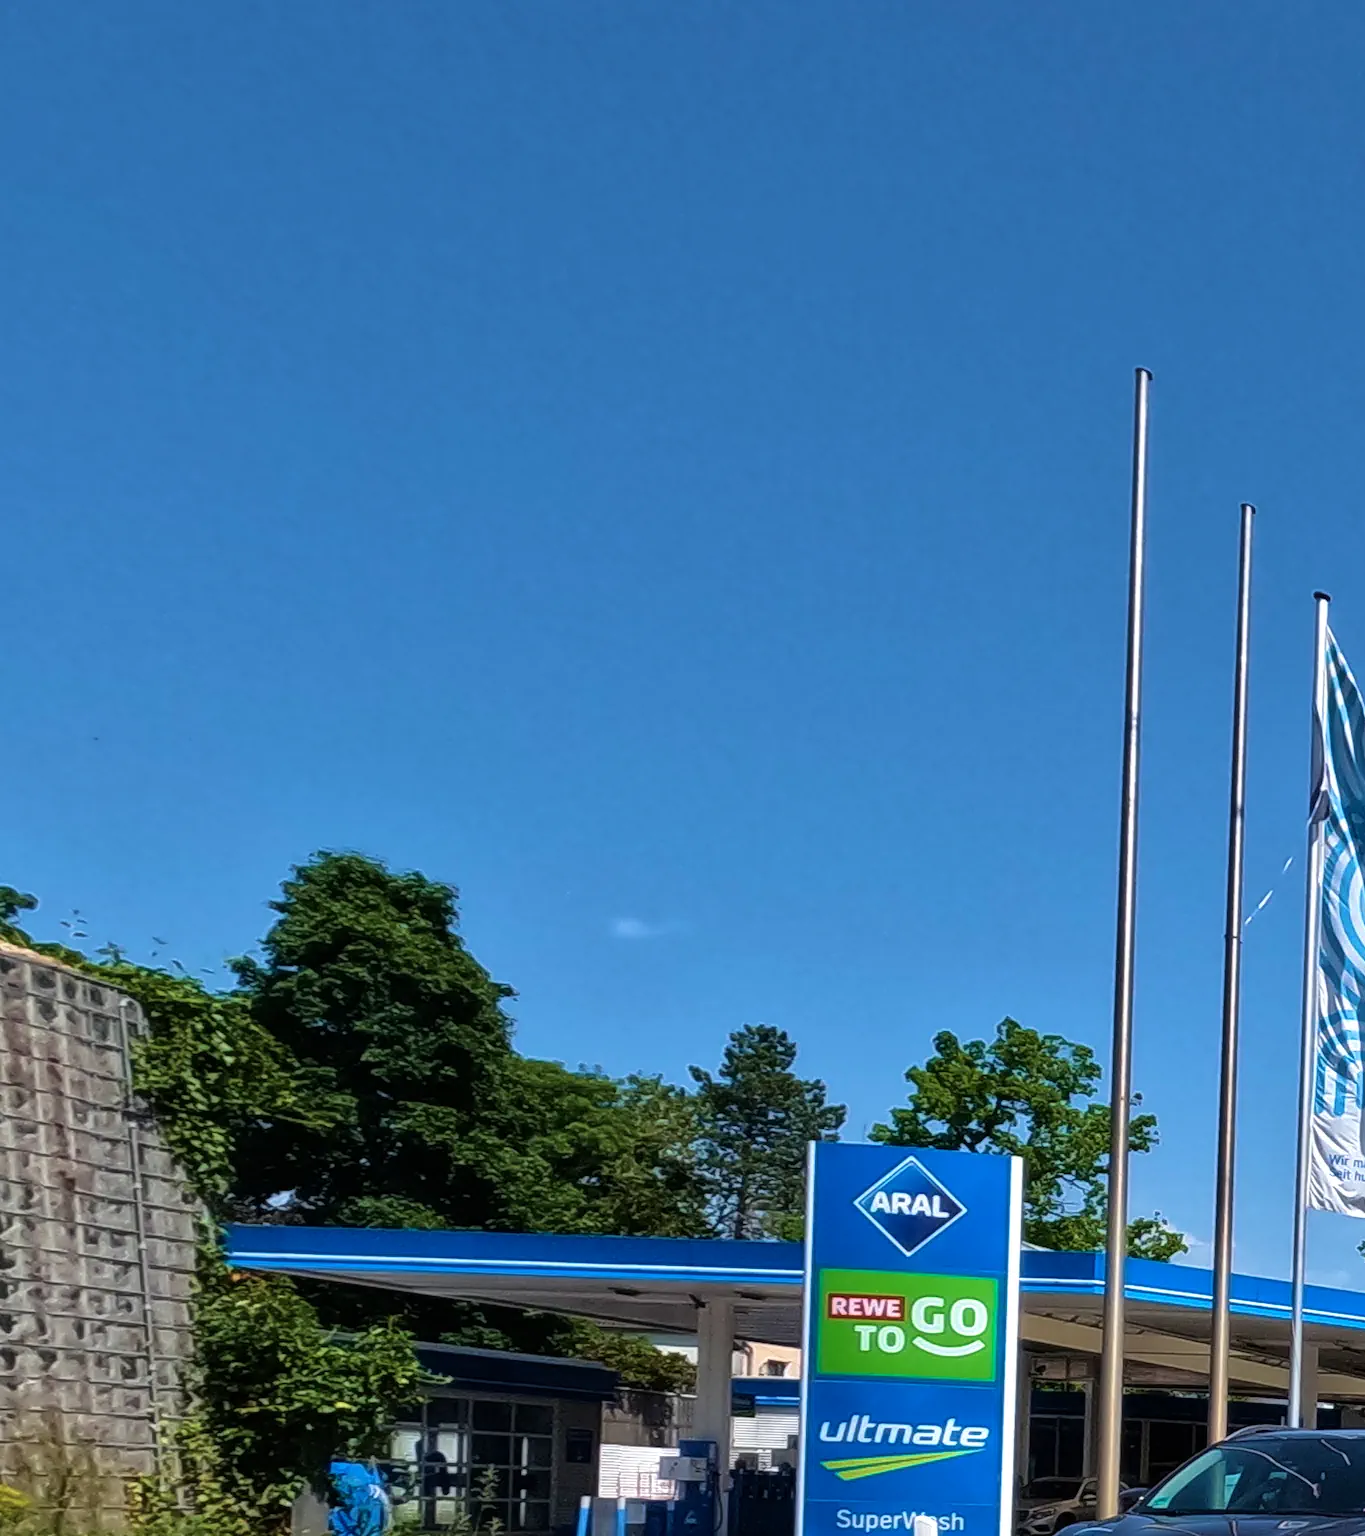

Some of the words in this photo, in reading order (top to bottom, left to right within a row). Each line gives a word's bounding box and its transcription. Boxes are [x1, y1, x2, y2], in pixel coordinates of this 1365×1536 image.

[870, 1190, 950, 1219] ARAL
[831, 1296, 902, 1318] REWE
[854, 1324, 906, 1354] TO
[911, 1296, 988, 1337] GO
